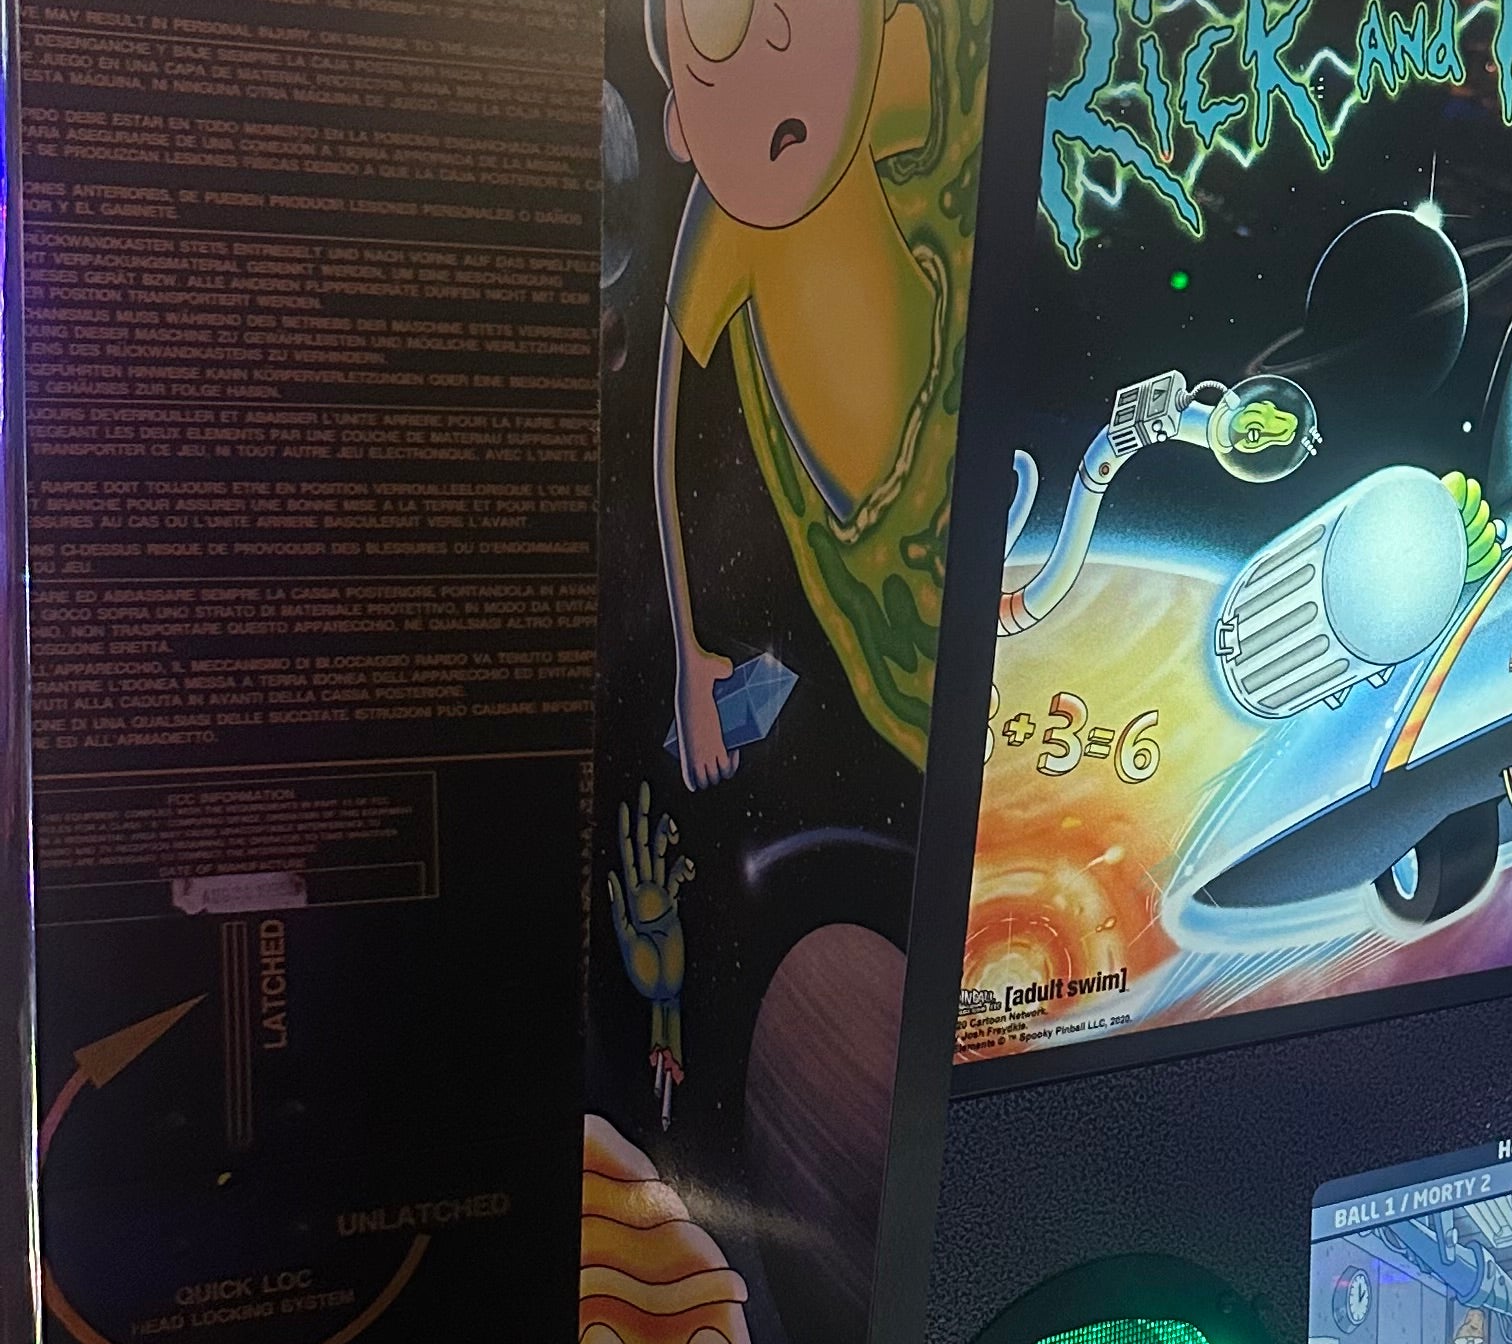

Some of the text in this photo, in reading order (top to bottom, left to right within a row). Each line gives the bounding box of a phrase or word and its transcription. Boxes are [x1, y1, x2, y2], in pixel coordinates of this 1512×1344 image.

[167, 793, 196, 805] FCC
[260, 918, 288, 1050] LATCHED
[961, 1026, 985, 1041] Josh
[969, 1013, 1007, 1028] Cartoon
[1019, 1028, 1054, 1043] Spooky
[1055, 1022, 1087, 1035] Pinball
[336, 1192, 513, 1238] UNLATCHED
[1334, 1200, 1380, 1229] BALL
[1384, 1197, 1396, 1216] 1
[1412, 1176, 1478, 1210] MORTY
[1480, 1173, 1492, 1193] 2
[173, 1267, 315, 1306] QUICK LOC
[129, 1286, 357, 1340] HEAD LOCKING SYSTEM
